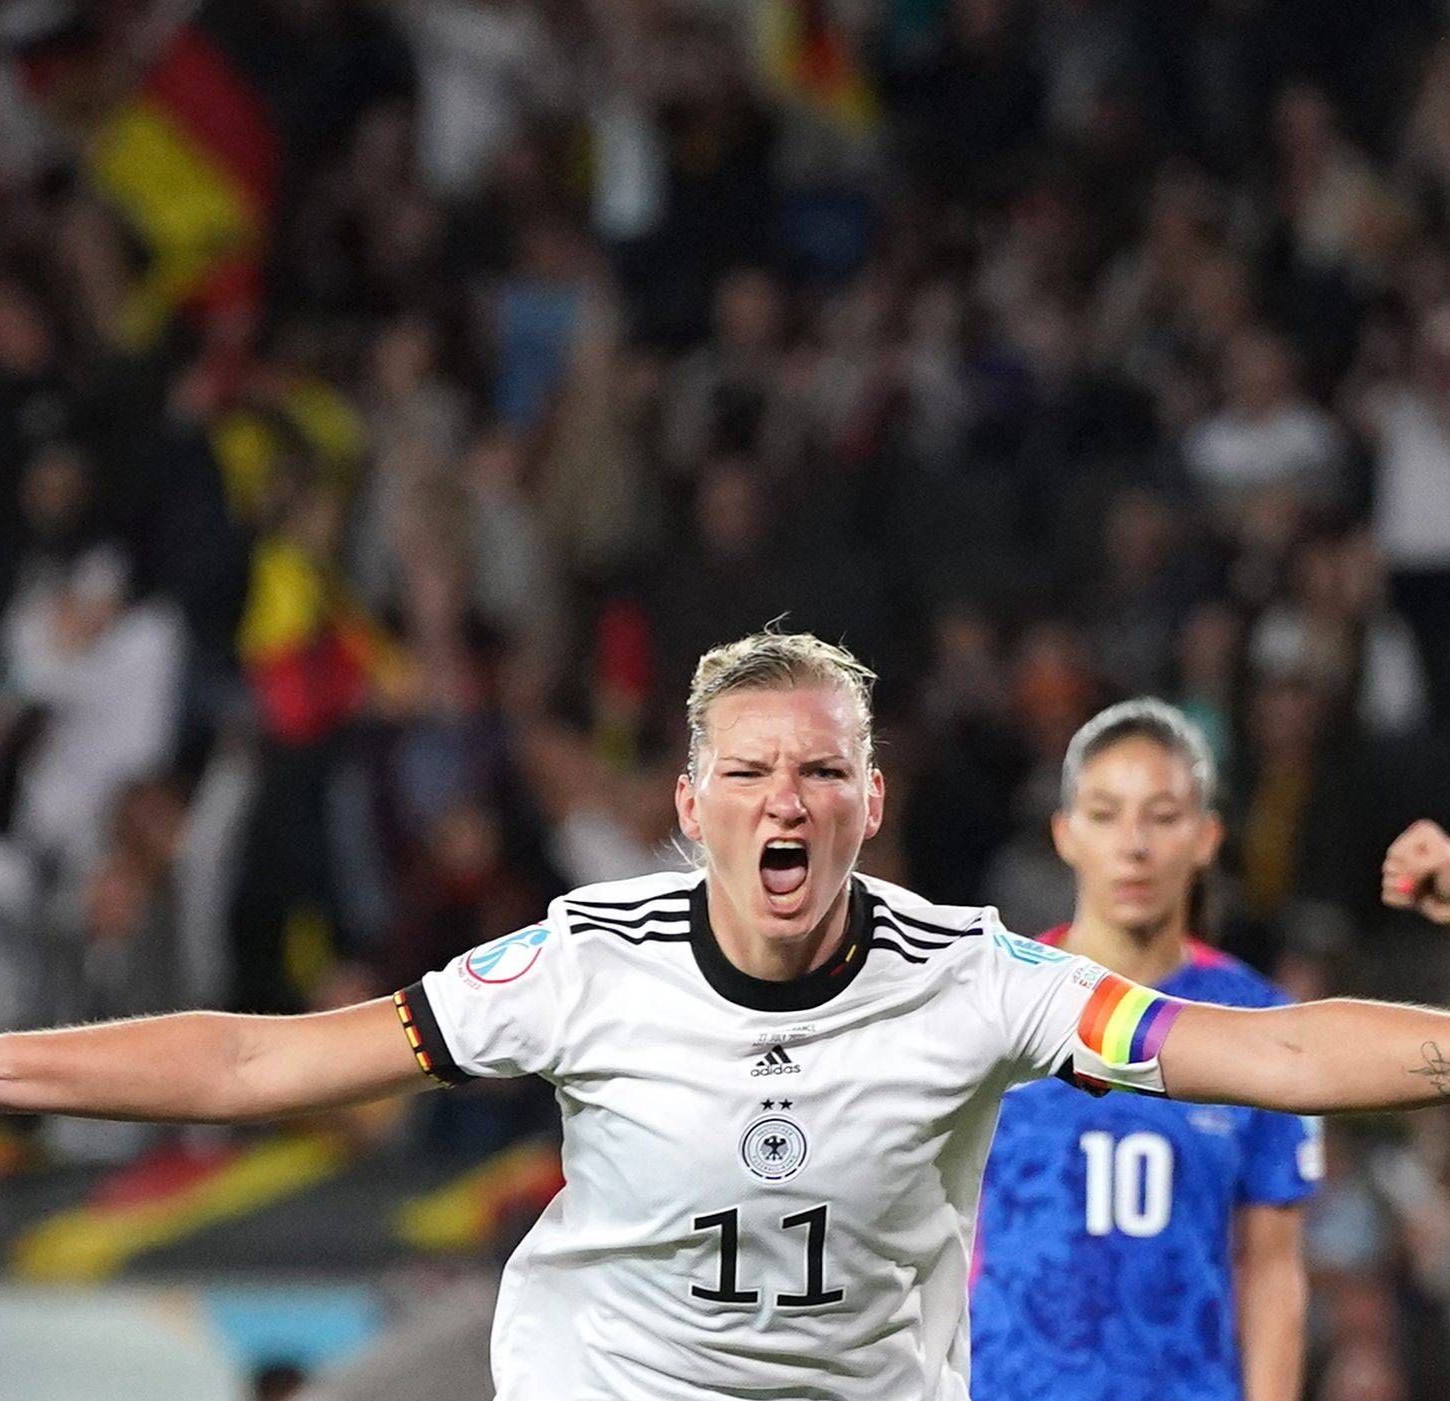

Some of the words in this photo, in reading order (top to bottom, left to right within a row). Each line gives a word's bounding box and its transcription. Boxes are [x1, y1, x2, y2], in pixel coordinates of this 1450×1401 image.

[750, 1064, 801, 1077] adidas
[1079, 1131, 1175, 1237] 10
[691, 1203, 845, 1308] 11
